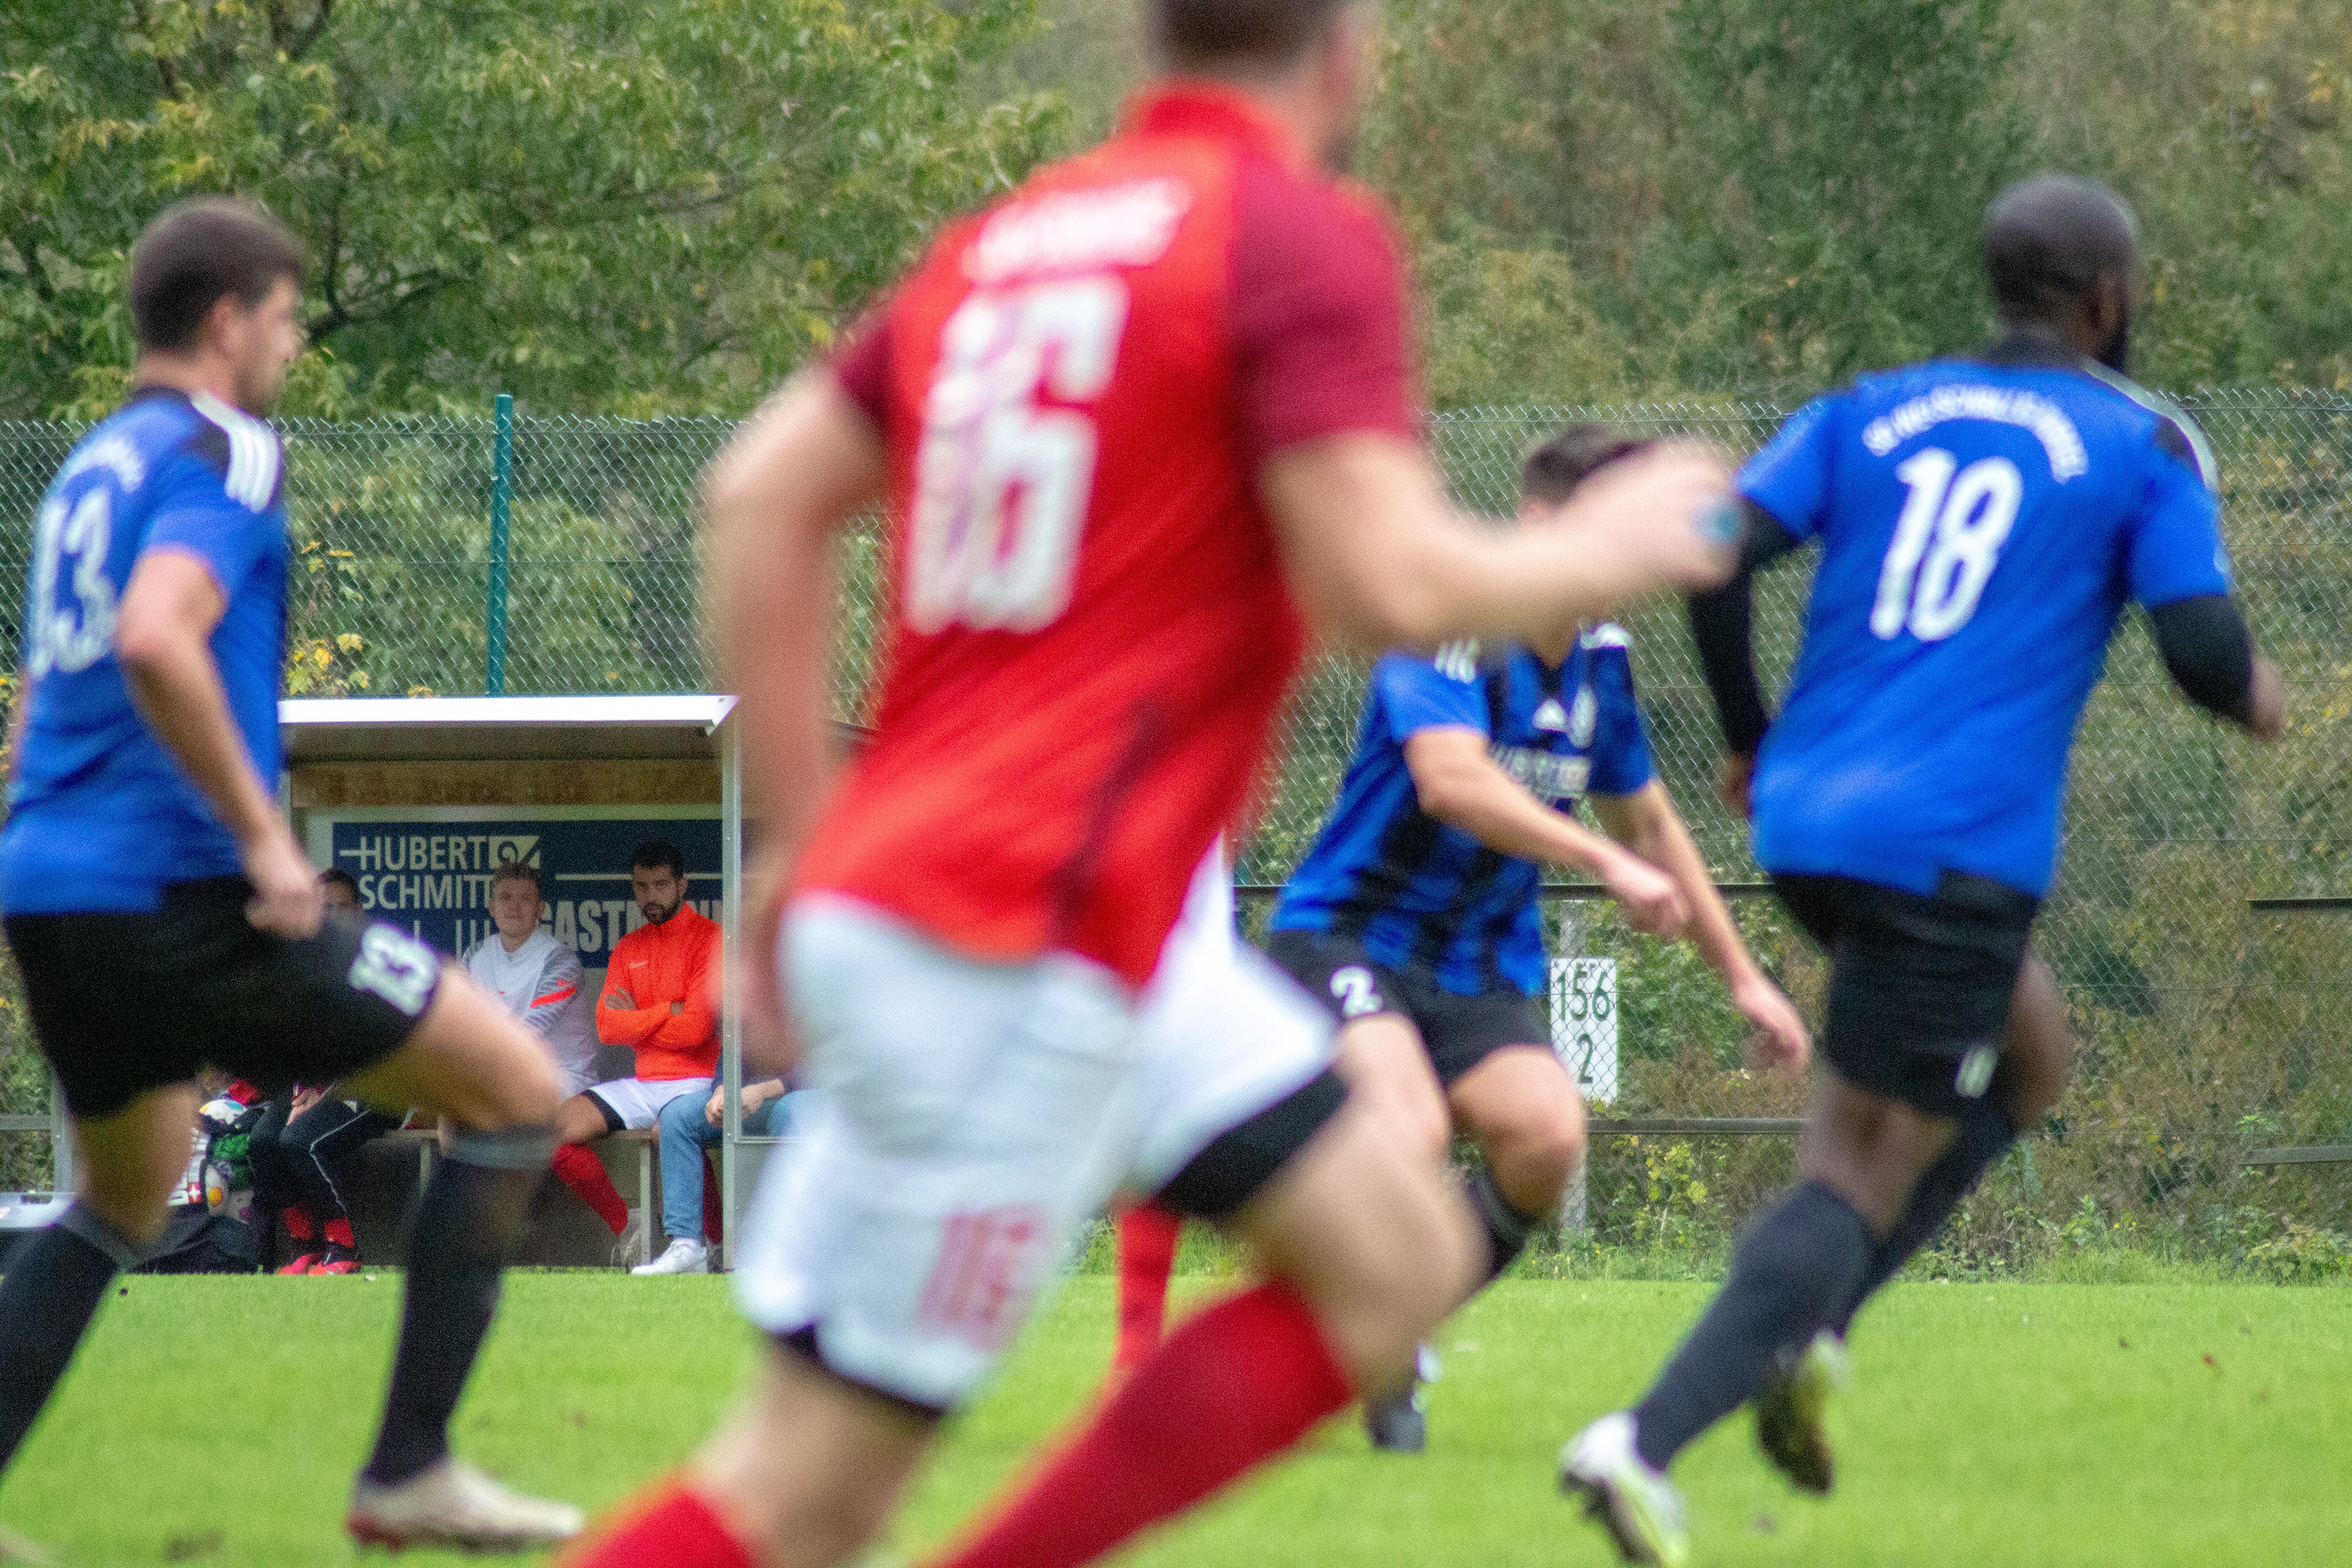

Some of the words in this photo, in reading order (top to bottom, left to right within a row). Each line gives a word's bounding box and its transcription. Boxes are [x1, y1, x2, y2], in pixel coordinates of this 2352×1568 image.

[1871, 447, 2022, 642] 18
[26, 486, 124, 679] 13
[359, 835, 489, 871] HUBERT
[359, 873, 495, 910] SCHMITT
[348, 922, 437, 1017] 13
[1329, 965, 1382, 1017] 2
[1556, 970, 1610, 1022] 156
[1576, 1032, 1594, 1085] 2
